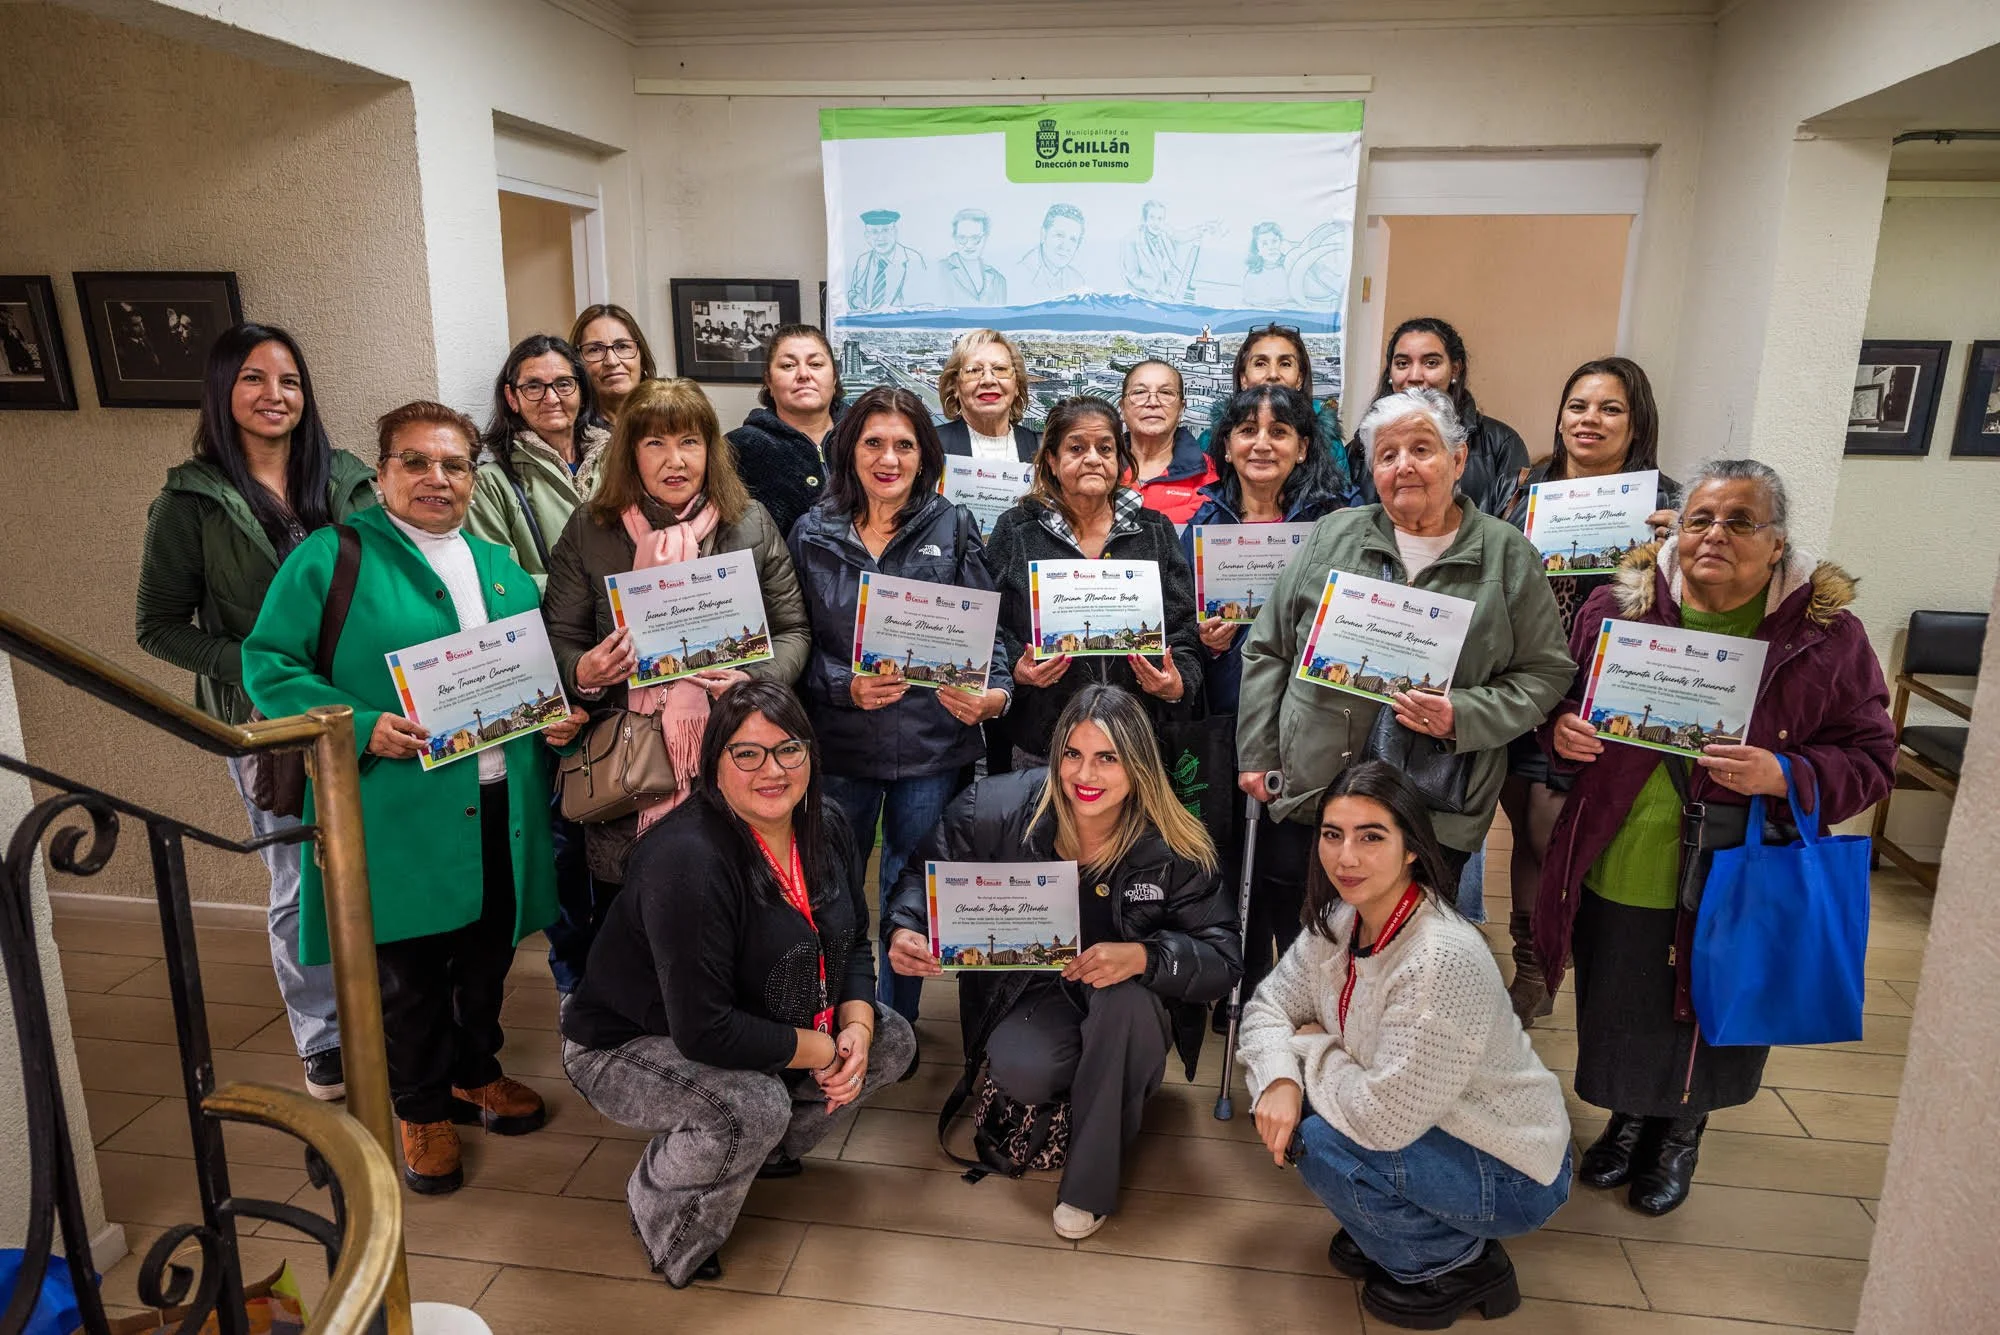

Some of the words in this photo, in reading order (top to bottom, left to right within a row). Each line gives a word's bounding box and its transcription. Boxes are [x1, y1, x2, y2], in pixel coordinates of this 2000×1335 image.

[1218, 561, 1244, 570] Carmen
[1246, 561, 1275, 571] Cifuentes
[1053, 594, 1081, 604] Miriam
[1335, 615, 1363, 628] Carmen
[1366, 622, 1402, 638] Navarrete
[1404, 632, 1439, 647] Riquelme
[438, 684, 455, 696] Rosa
[458, 674, 486, 689] Troncoso
[489, 663, 520, 680] Carrasco
[1607, 663, 1650, 679] Margarita
[1654, 672, 1690, 686] Cifuentes
[1692, 678, 1736, 694] Navarrete
[955, 904, 985, 913] Claudia
[988, 903, 1015, 914] Pantoja
